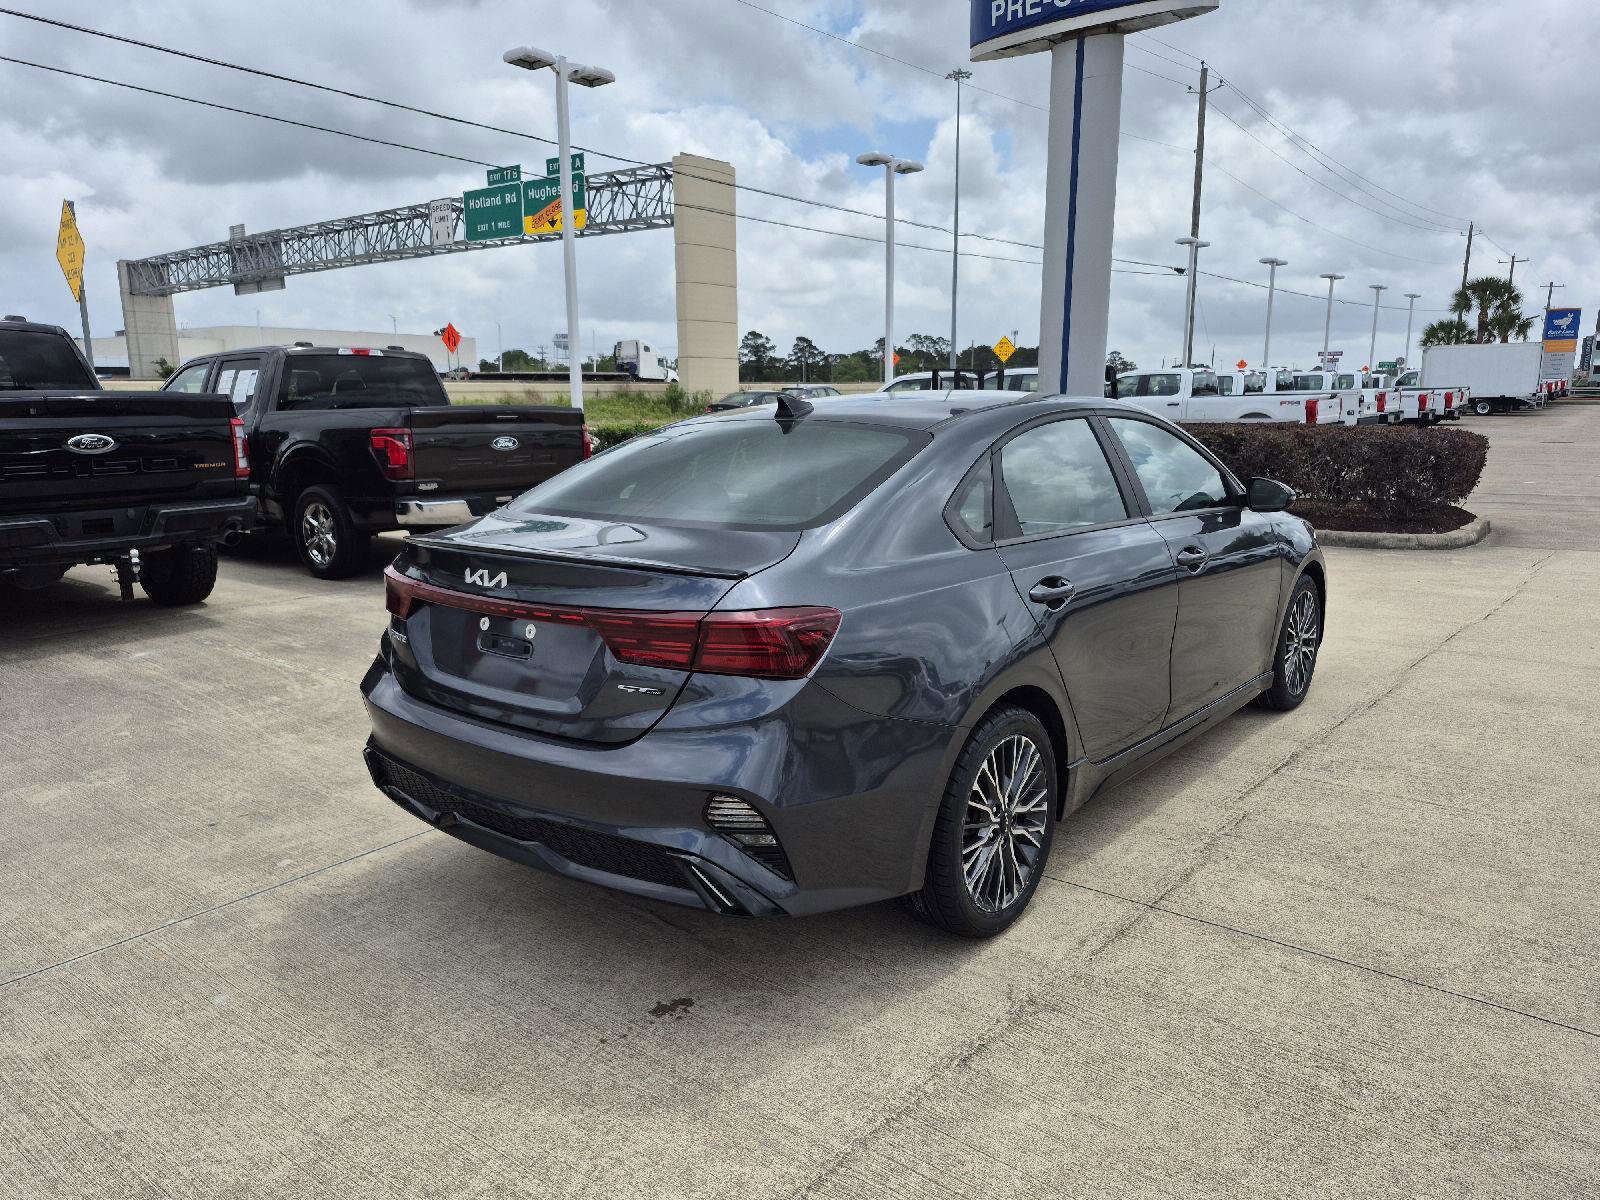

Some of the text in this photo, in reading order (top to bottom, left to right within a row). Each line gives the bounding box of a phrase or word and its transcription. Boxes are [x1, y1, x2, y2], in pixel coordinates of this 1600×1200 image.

[549, 162, 560, 171] EXI
[528, 185, 561, 201] Hughes
[469, 191, 517, 210] Holland Rd
[432, 203, 450, 212] SPEED
[545, 201, 562, 217] CLOSE
[435, 215, 449, 223] LIMIT
[477, 223, 489, 231] EXIT
[491, 221, 496, 231] 1
[80, 437, 104, 449] Ford
[465, 567, 507, 589] KIA
